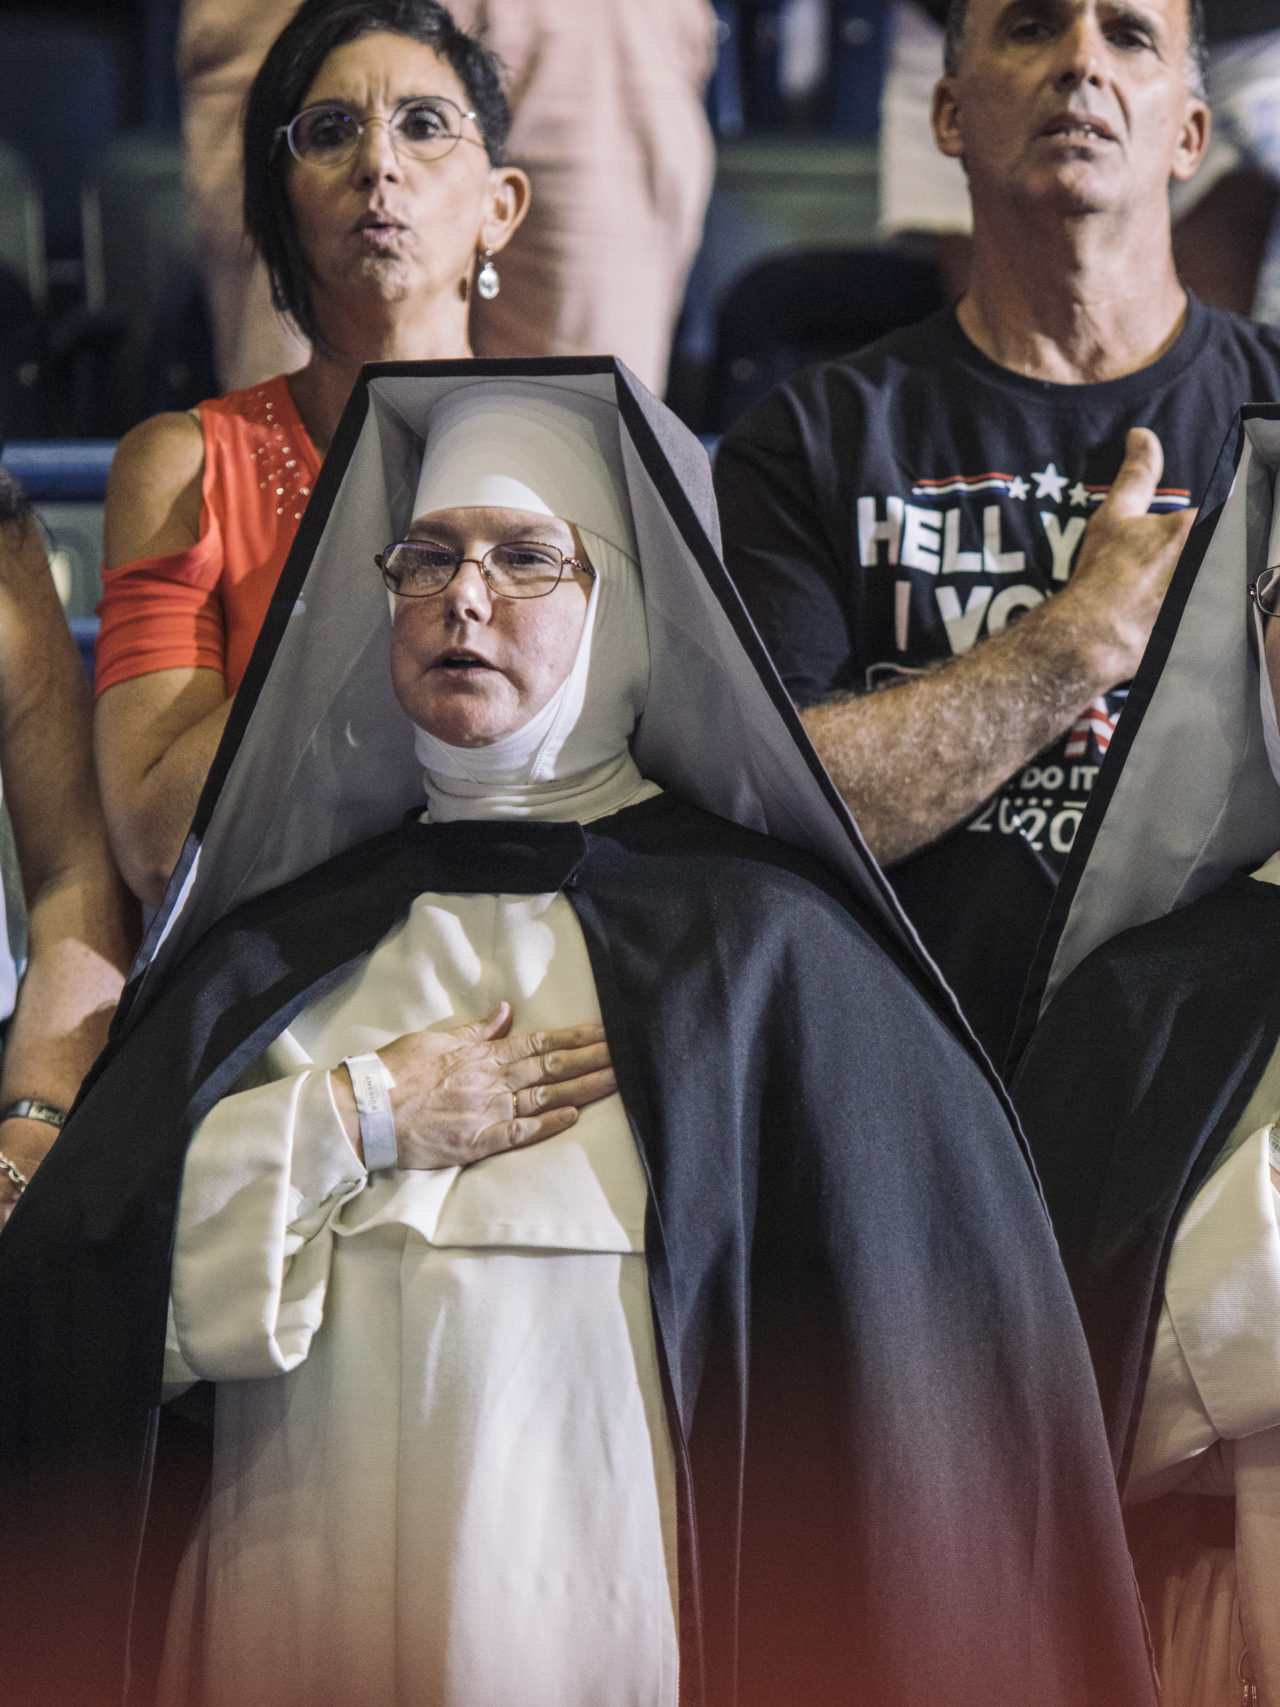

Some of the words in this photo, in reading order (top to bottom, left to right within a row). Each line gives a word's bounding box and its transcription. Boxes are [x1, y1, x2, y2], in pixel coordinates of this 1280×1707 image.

[857, 496, 1026, 575] HELL
[895, 580, 911, 652] I
[1020, 765, 1064, 790] DO
[1069, 765, 1100, 791] IT
